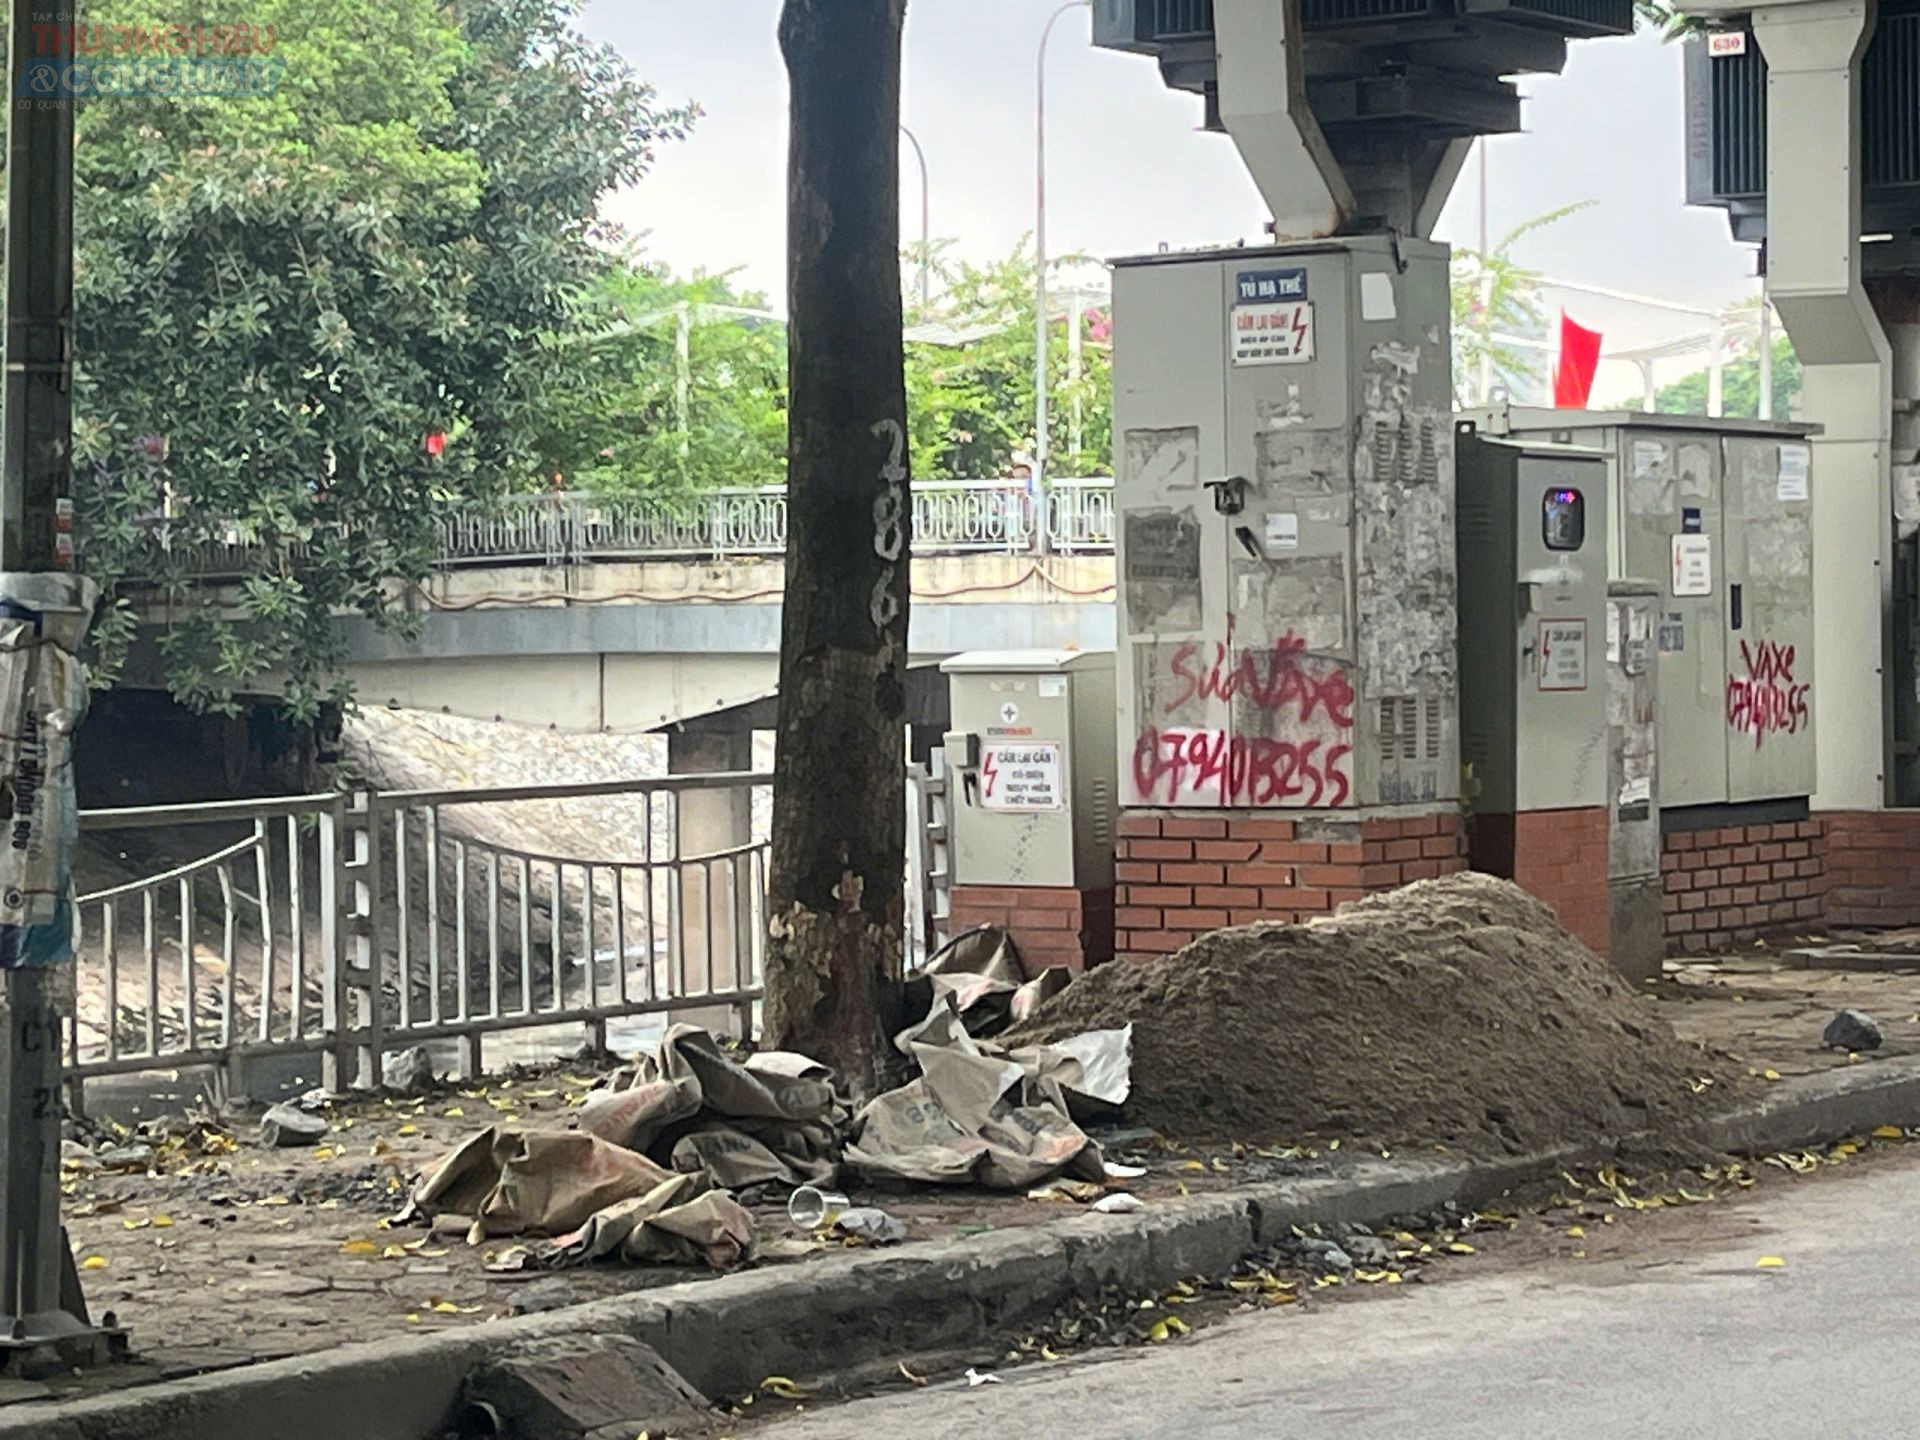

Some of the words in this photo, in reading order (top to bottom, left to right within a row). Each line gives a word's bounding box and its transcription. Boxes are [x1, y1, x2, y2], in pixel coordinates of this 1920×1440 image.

[1241, 275, 1256, 298] TỦ
[1258, 280, 1276, 299] HẠ
[1278, 270, 1304, 295] THẾ
